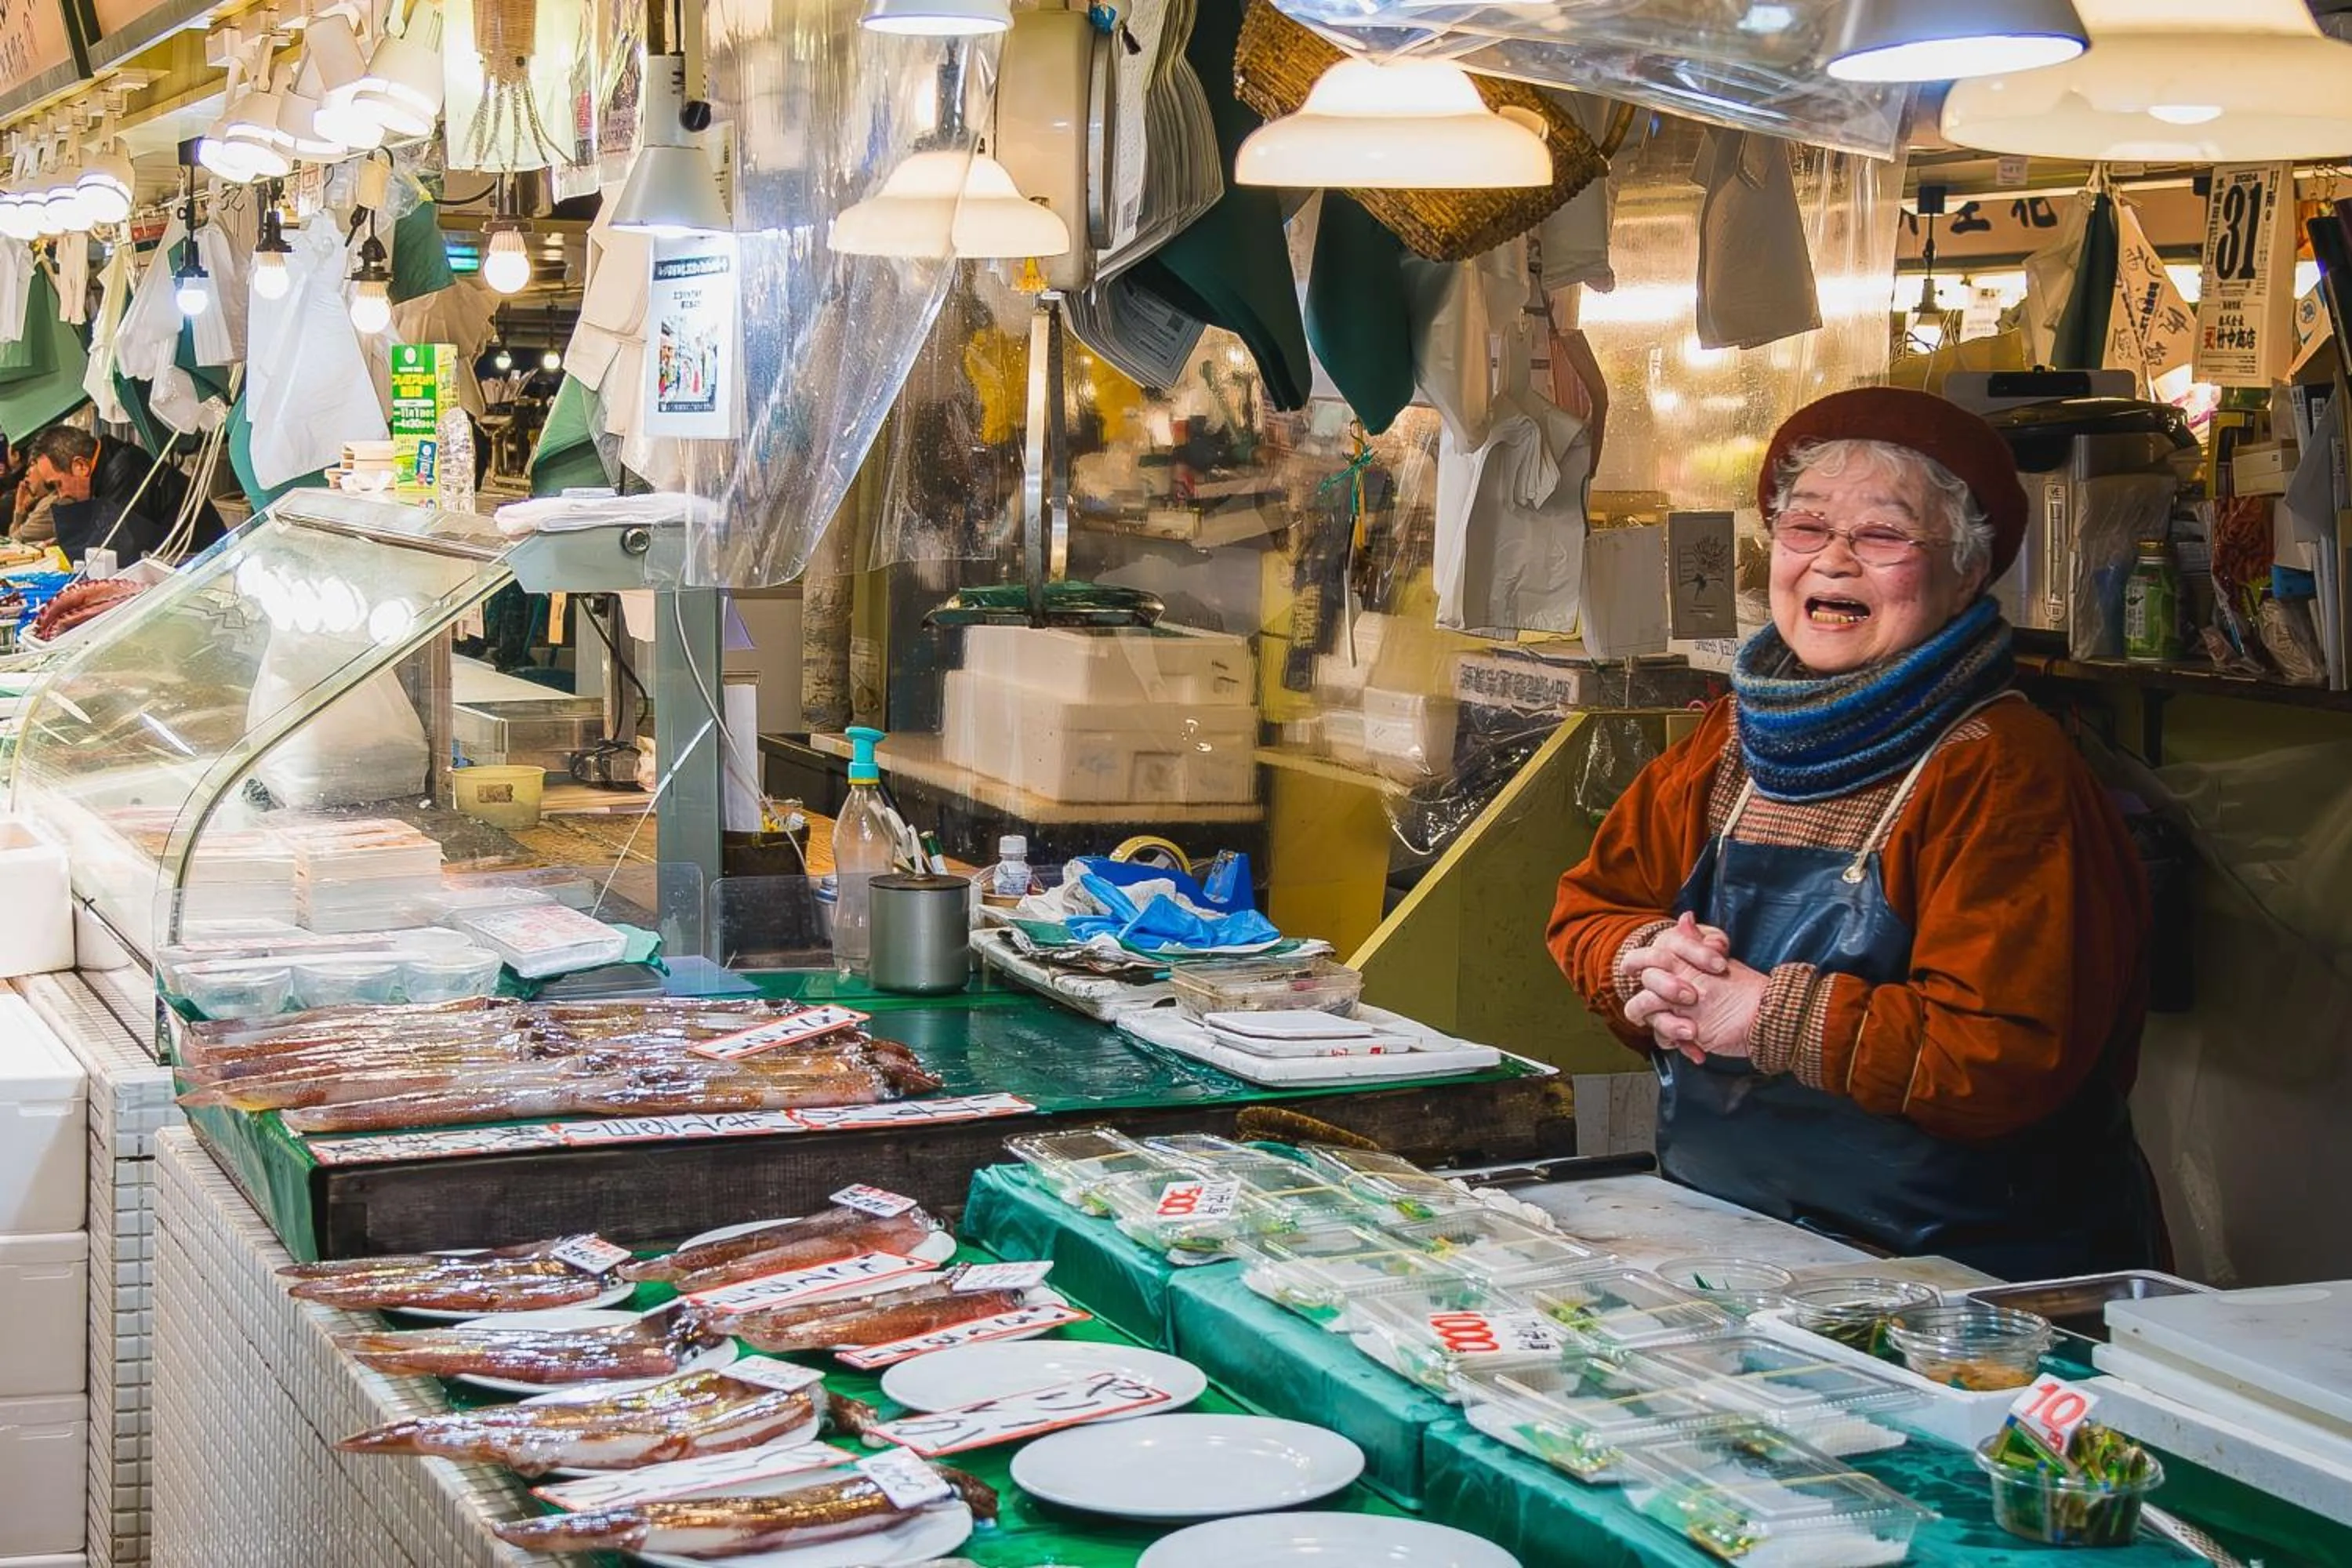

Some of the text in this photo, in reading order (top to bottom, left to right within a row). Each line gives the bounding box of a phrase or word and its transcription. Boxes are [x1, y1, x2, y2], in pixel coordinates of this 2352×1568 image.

[2216, 182, 2263, 280] 31
[1156, 1185, 1203, 1215] 500
[1429, 1312, 1501, 1352] 1000
[2022, 1384, 2086, 1428] 10
